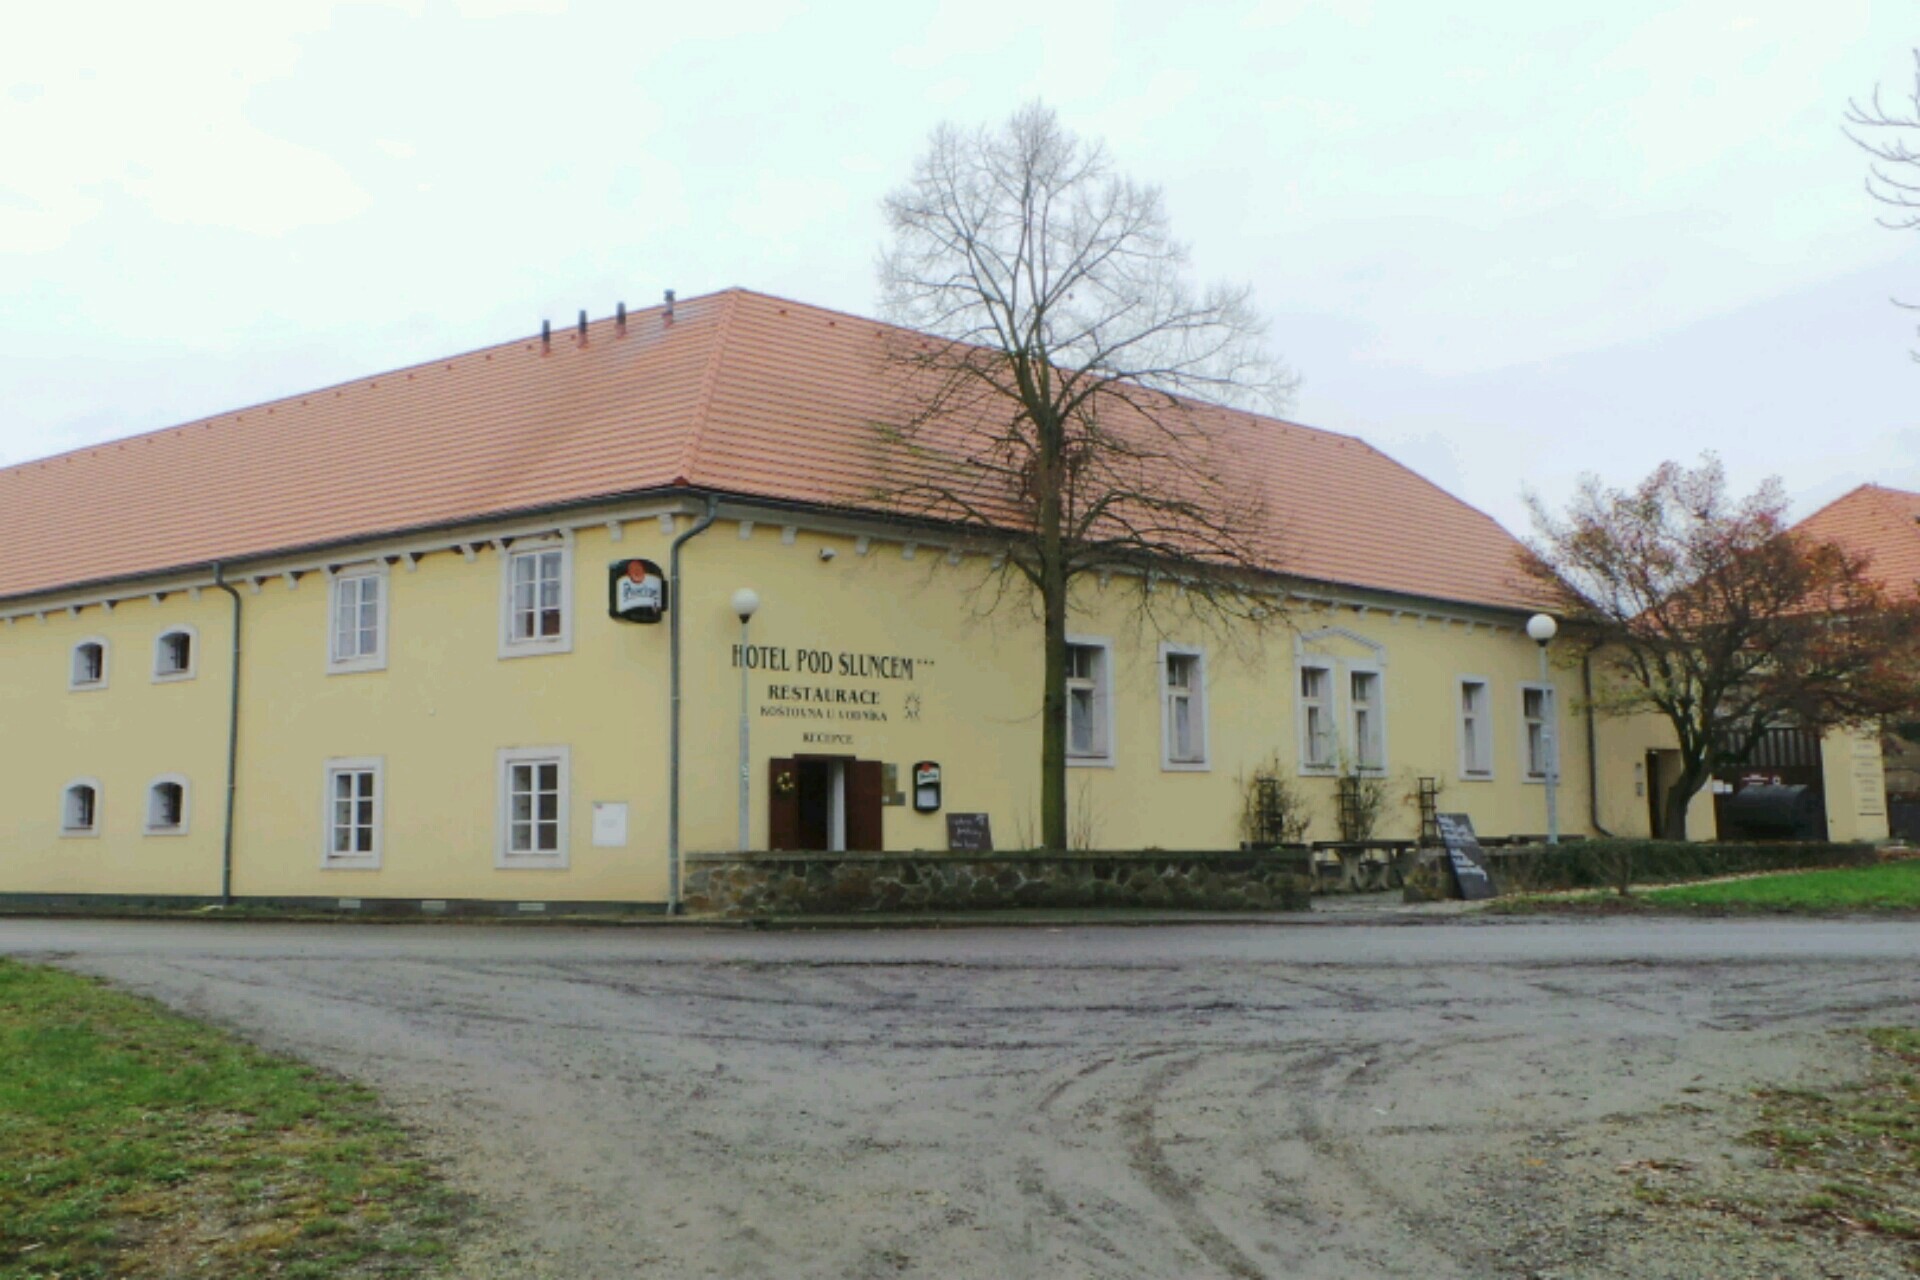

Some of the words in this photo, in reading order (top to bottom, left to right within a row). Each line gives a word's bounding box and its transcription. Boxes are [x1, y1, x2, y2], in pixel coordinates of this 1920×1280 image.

[732, 644, 790, 671] HOTEL
[797, 649, 833, 674] POD
[839, 653, 913, 680] SLUNCEM
[768, 685, 880, 704] RESTAURACE
[803, 732, 853, 744] RECEPCE
